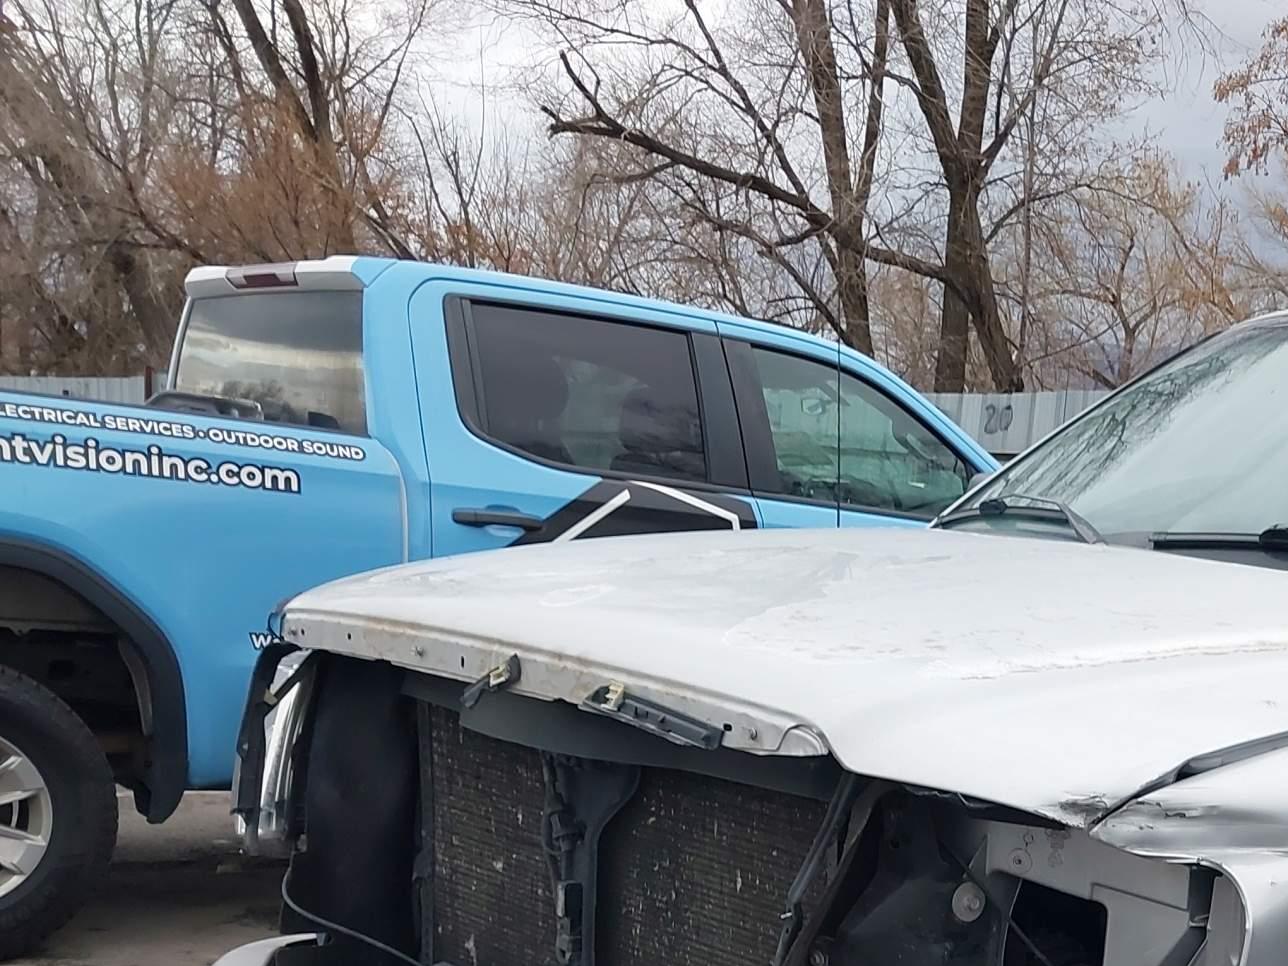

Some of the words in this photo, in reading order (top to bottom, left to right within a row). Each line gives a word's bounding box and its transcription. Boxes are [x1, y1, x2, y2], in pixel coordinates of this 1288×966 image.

[103, 414, 195, 438] SERVICES
[208, 428, 299, 452] OUTDOOR
[302, 440, 365, 461] SOUND
